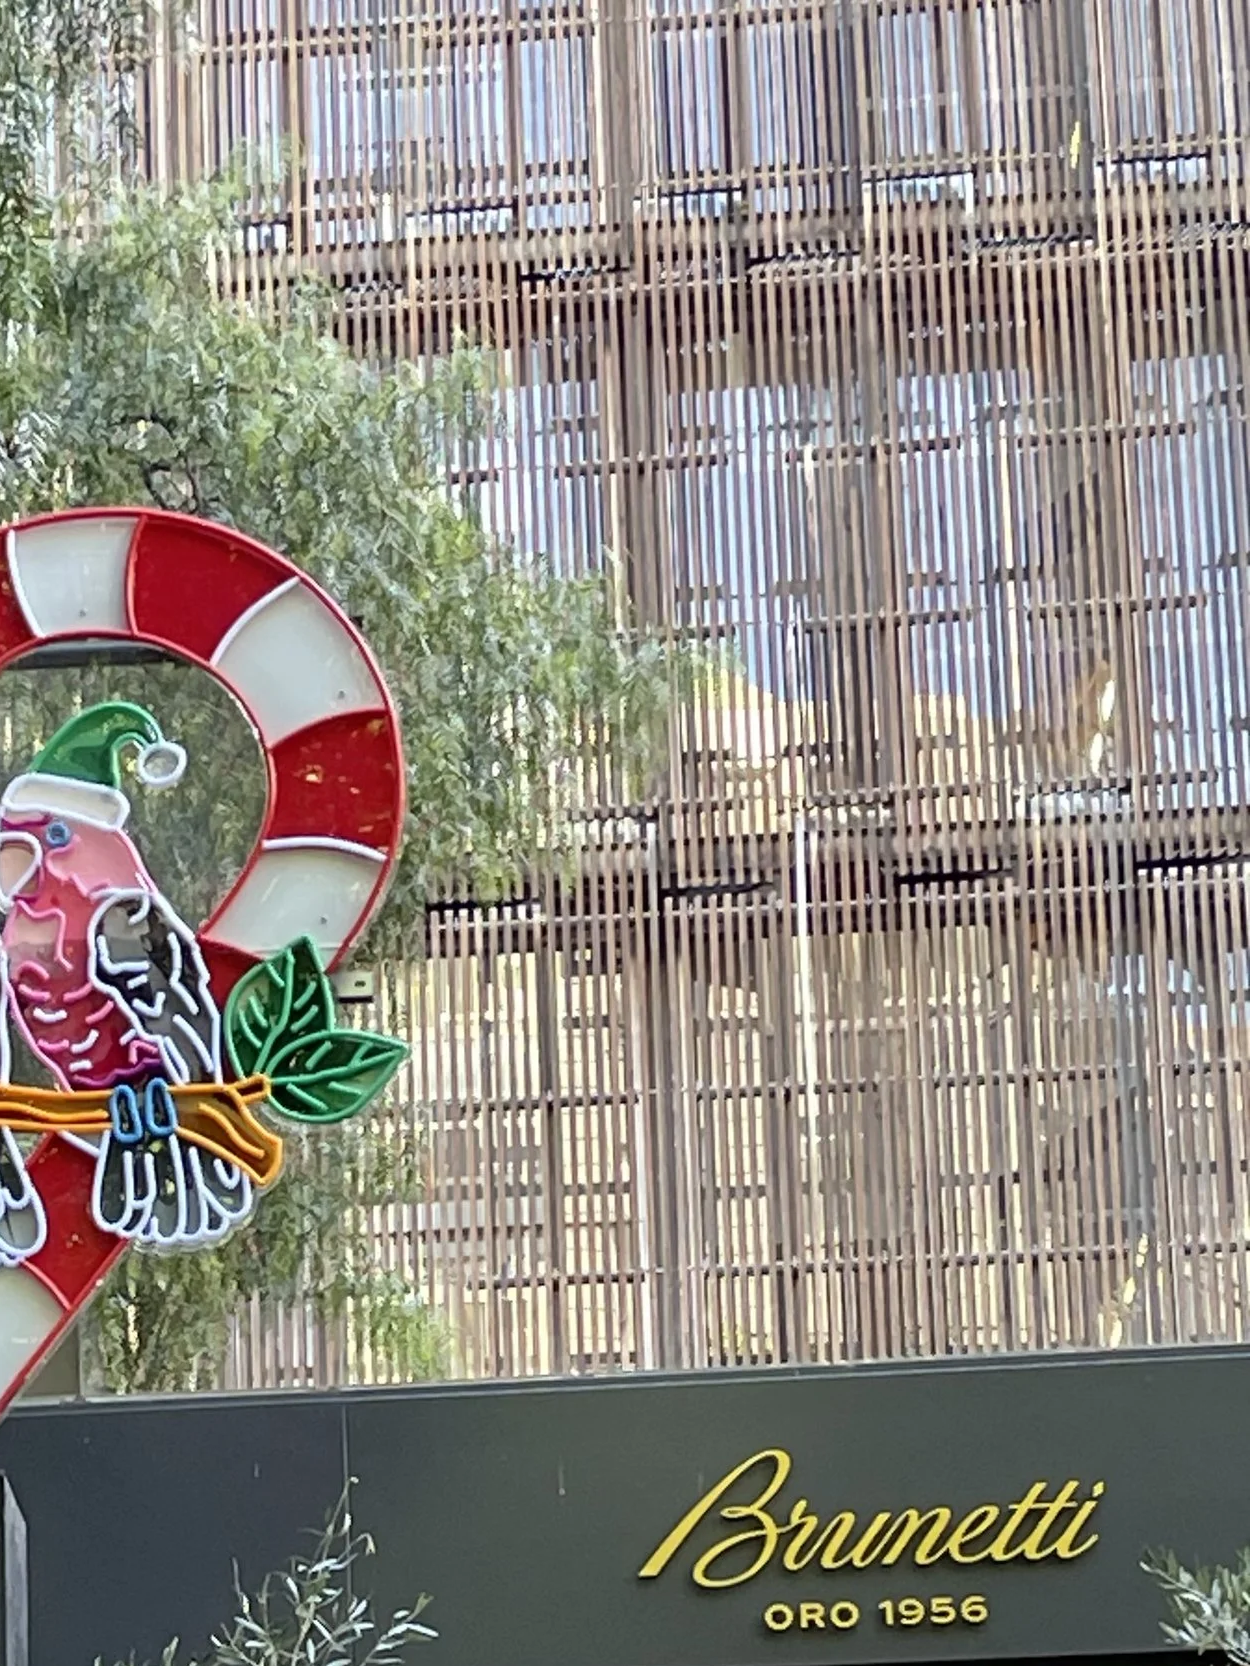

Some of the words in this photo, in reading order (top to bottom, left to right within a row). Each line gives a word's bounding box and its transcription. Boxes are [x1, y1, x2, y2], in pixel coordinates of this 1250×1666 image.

[638, 1447, 1106, 1588] Brunetti
[764, 1602, 861, 1630] ORO
[877, 1595, 990, 1625] 1956
